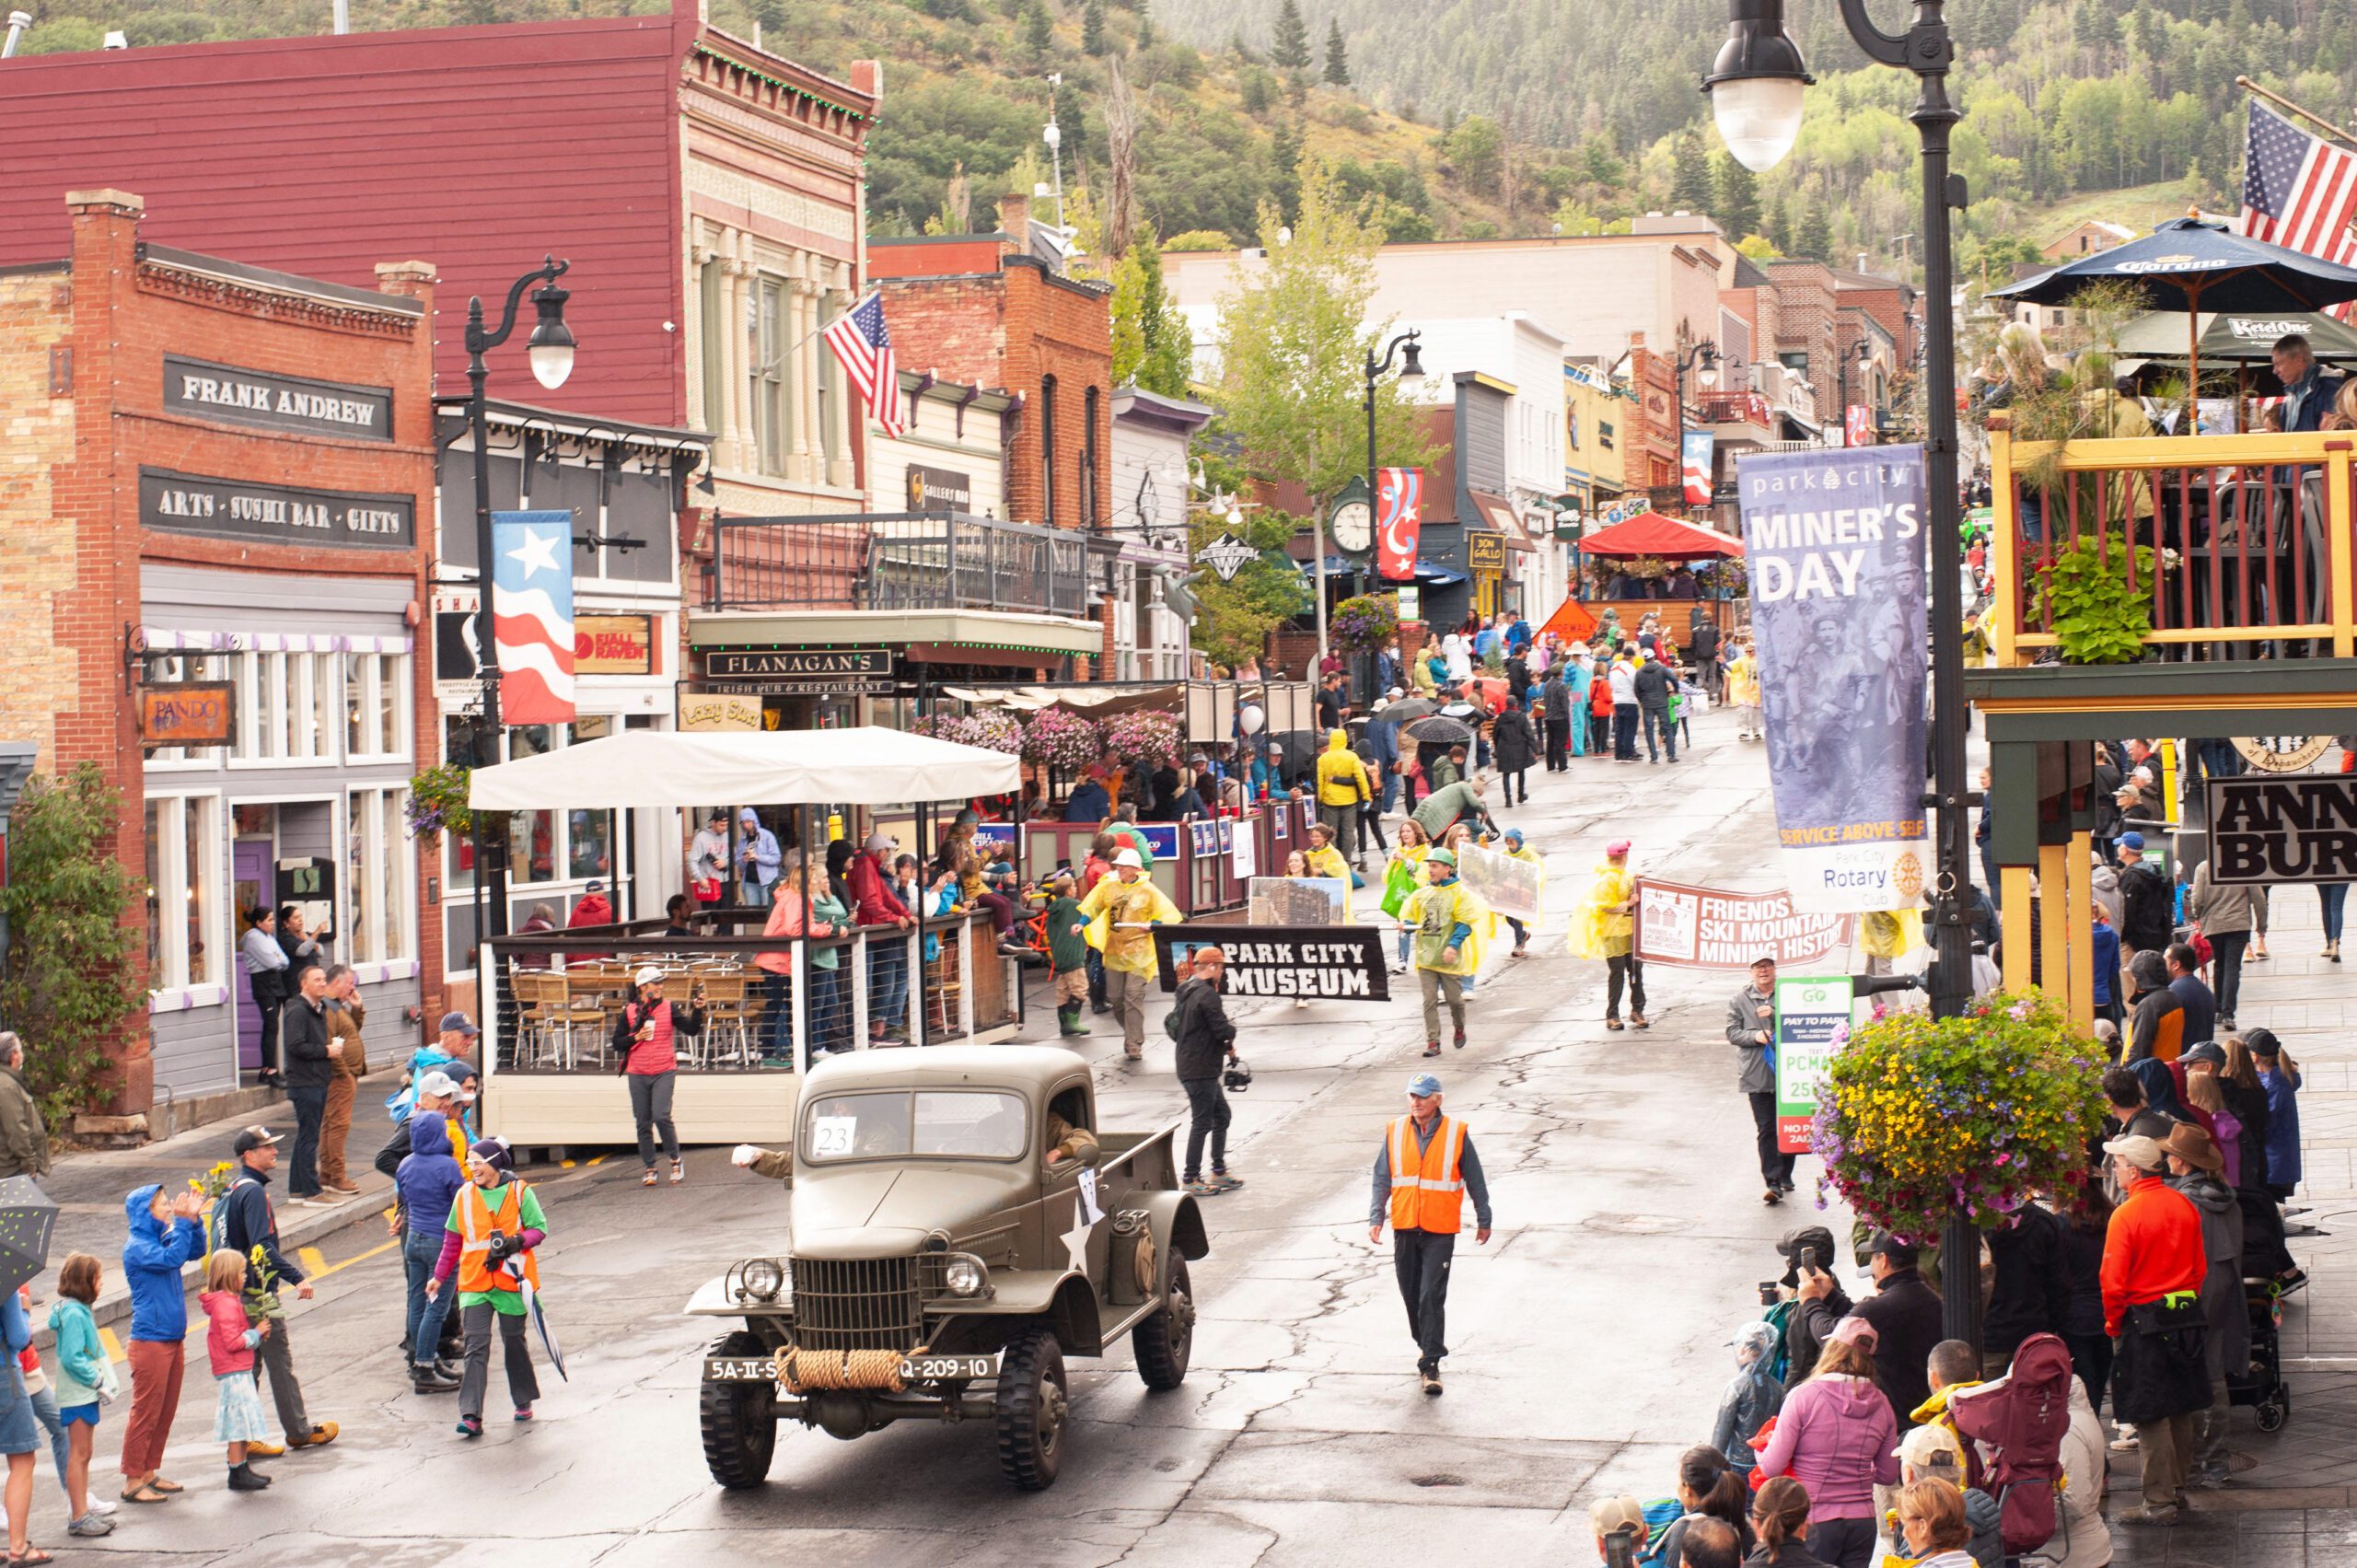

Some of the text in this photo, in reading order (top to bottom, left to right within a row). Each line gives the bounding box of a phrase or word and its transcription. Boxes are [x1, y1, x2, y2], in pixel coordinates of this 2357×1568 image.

[2114, 258, 2228, 273] Corona
[181, 376, 375, 425] FRANK ANDREW
[1753, 465, 1909, 498] park city
[923, 484, 954, 502] GALLERY
[158, 490, 400, 534] ARTS SUSHI BAR GIFTS
[1751, 503, 1919, 551] MINER'S
[1474, 549, 1501, 559] GALLO
[1478, 539, 1494, 548] DON
[1755, 549, 1865, 603] DAY
[717, 684, 752, 694] IRISH
[798, 681, 883, 693] RESTAURANT
[155, 700, 220, 719] PANDO
[682, 700, 759, 726] Lazy Sun
[1780, 820, 1926, 844] SERVICE ABOVE SELF
[1836, 849, 1887, 864] Park City
[1824, 869, 1887, 889] Rotary
[1701, 897, 1789, 921] FRIENDS
[1863, 893, 1887, 906] Club
[1699, 913, 1837, 944] SKI MOUNTAIN
[1699, 916, 1845, 964] MINING HISTORY
[1221, 943, 1364, 964] PARK CITY
[1225, 968, 1371, 996] MUSEUM
[1782, 1016, 1848, 1026] PAY TO PARK
[1783, 1123, 1801, 1132] NO
[819, 1127, 847, 1151] 23
[900, 1358, 989, 1379] Q-209-10
